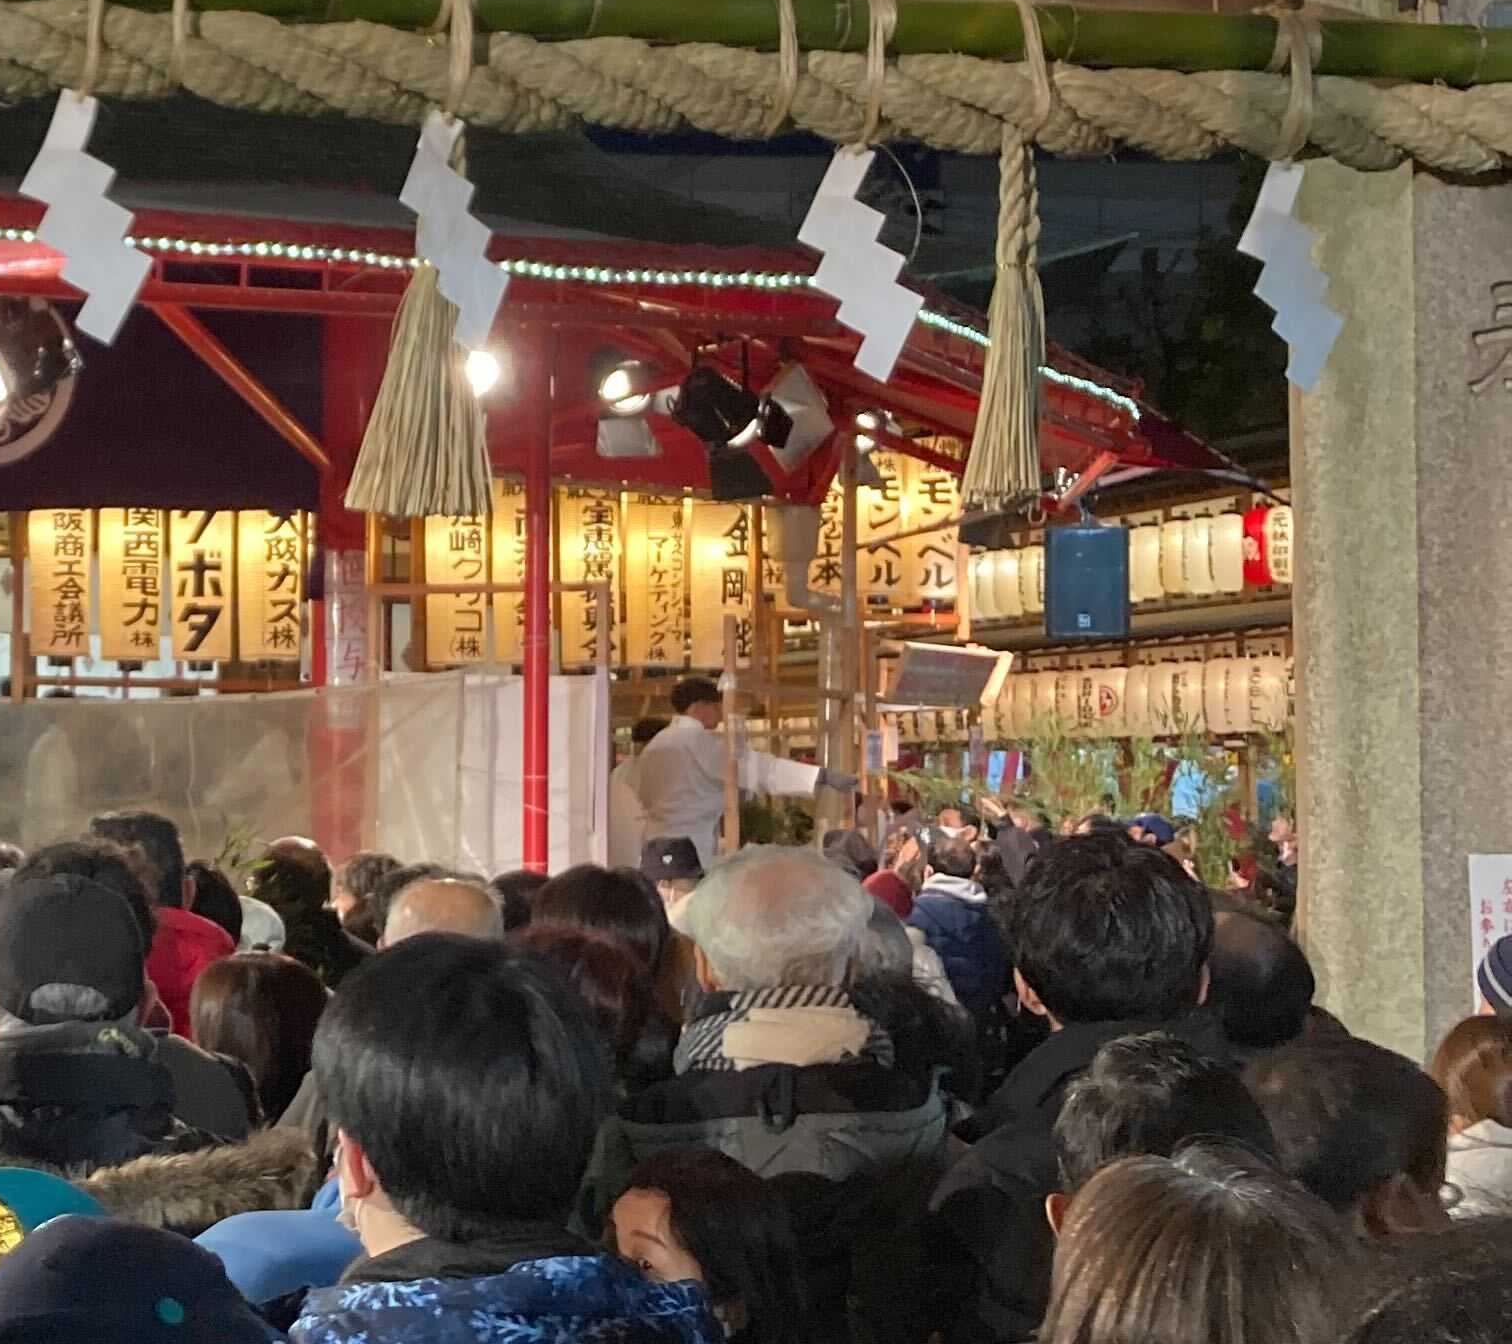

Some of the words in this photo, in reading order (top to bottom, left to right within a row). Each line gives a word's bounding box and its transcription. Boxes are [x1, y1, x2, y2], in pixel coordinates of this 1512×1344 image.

[50, 510, 85, 649] 阪商工会議所
